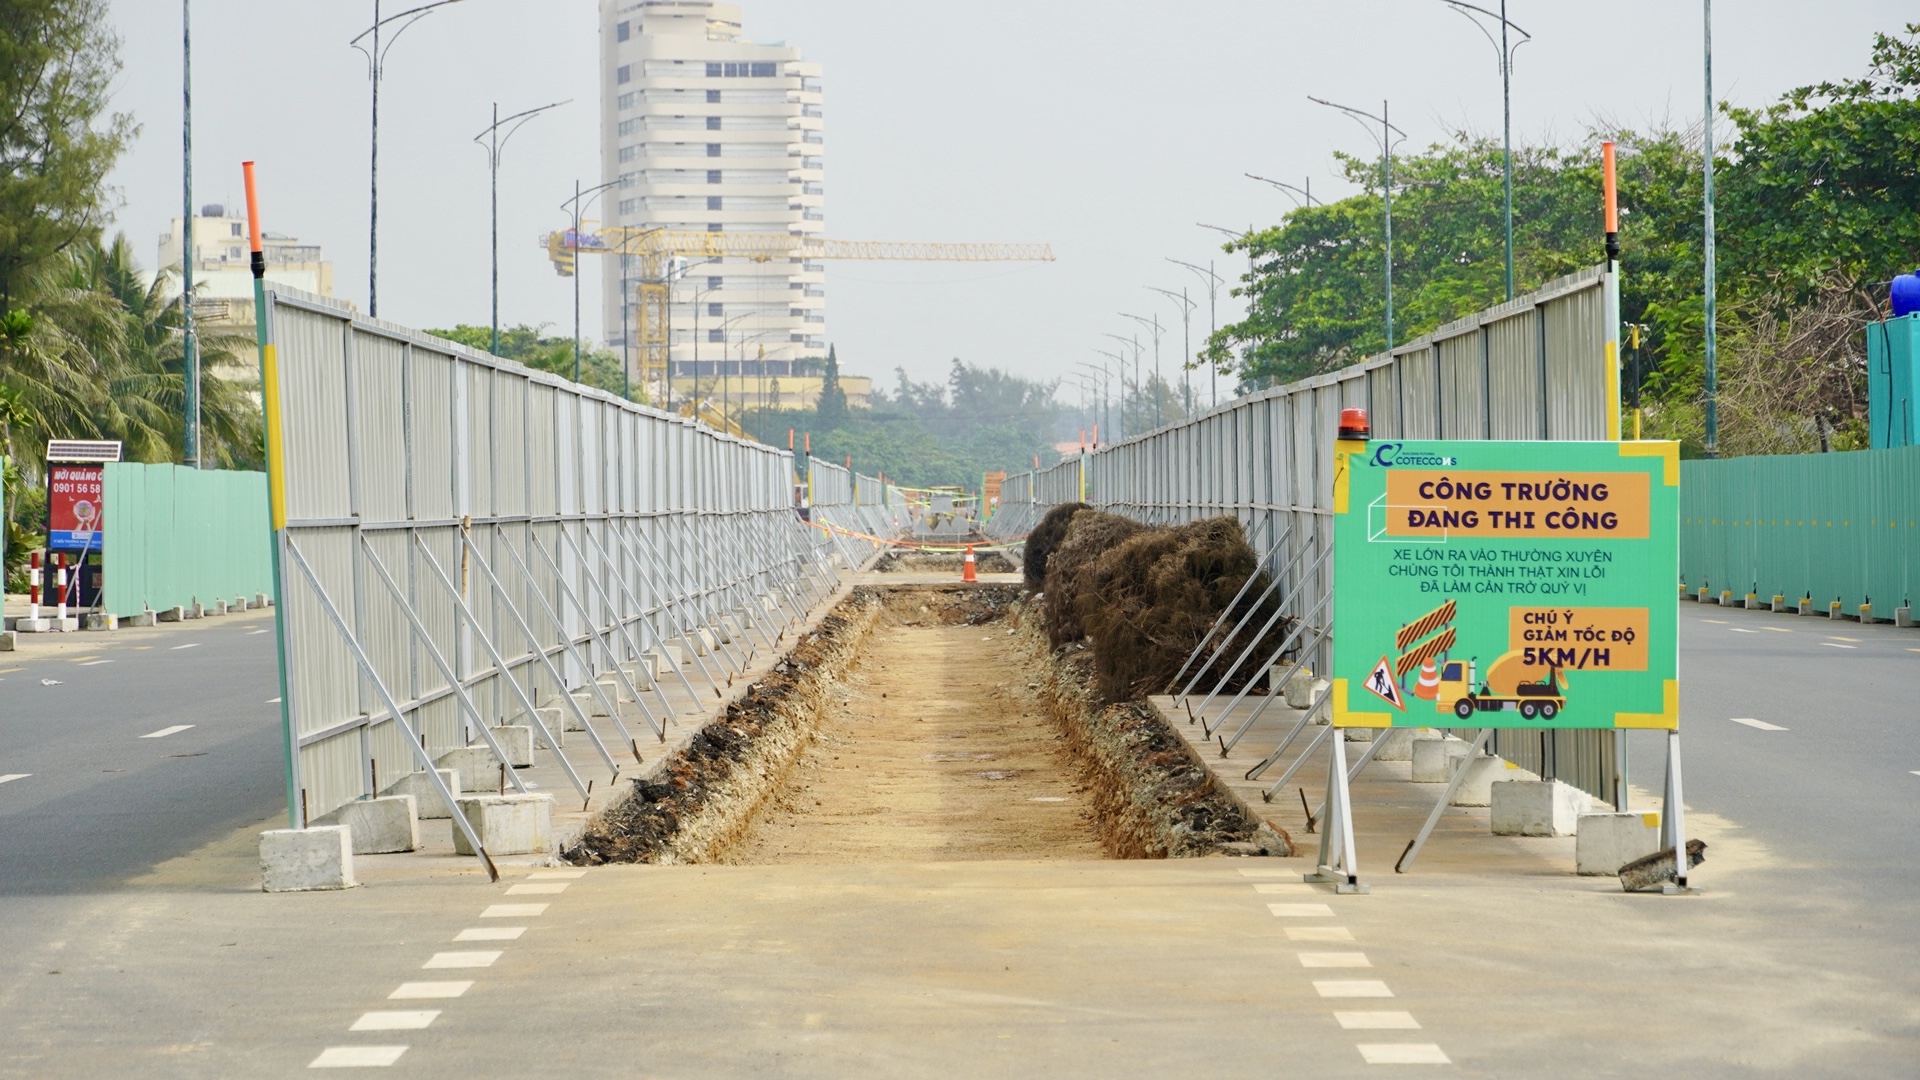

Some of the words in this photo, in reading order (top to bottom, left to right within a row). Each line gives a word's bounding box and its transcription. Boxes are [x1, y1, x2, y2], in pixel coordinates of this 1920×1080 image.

[54, 468, 69, 480] MỜI
[70, 468, 97, 481] QUẢNG
[53, 482, 75, 493] 0901
[77, 483, 88, 493] 56
[90, 484, 101, 494] 58
[1419, 477, 1492, 500] CÔNG
[1501, 478, 1609, 501] TRƯỜNG
[1408, 510, 1479, 528] ĐANG
[1488, 511, 1535, 529] THI
[1545, 507, 1618, 530] CÔNG
[1393, 549, 1411, 560] XE
[1415, 548, 1444, 561] LỚN
[1449, 550, 1467, 561] RA
[1470, 548, 1497, 562] VÀO
[1501, 549, 1562, 562] THƯỜNG
[1566, 549, 1612, 563] XUYÊN
[1389, 563, 1438, 577] CHÚNG
[1442, 564, 1464, 577] TÔI
[1468, 564, 1515, 577] THÀNH
[1517, 565, 1554, 580] THẬT
[1557, 567, 1580, 578] XIN
[1584, 564, 1605, 578] LỖI
[1420, 579, 1439, 593] ĐÃ
[1443, 580, 1471, 593] LÀM
[1475, 579, 1503, 593] CẢN
[1507, 580, 1537, 594] TRỞ
[1540, 581, 1570, 594] QUÝ
[1573, 583, 1587, 596] VỊ
[1523, 609, 1557, 624] CHÚ
[1563, 609, 1574, 624] Ý
[1523, 625, 1567, 641] GIẢM
[1573, 624, 1606, 642] TỐC
[1611, 627, 1635, 645] ĐỘ
[1523, 647, 1610, 669] 5KM/H
